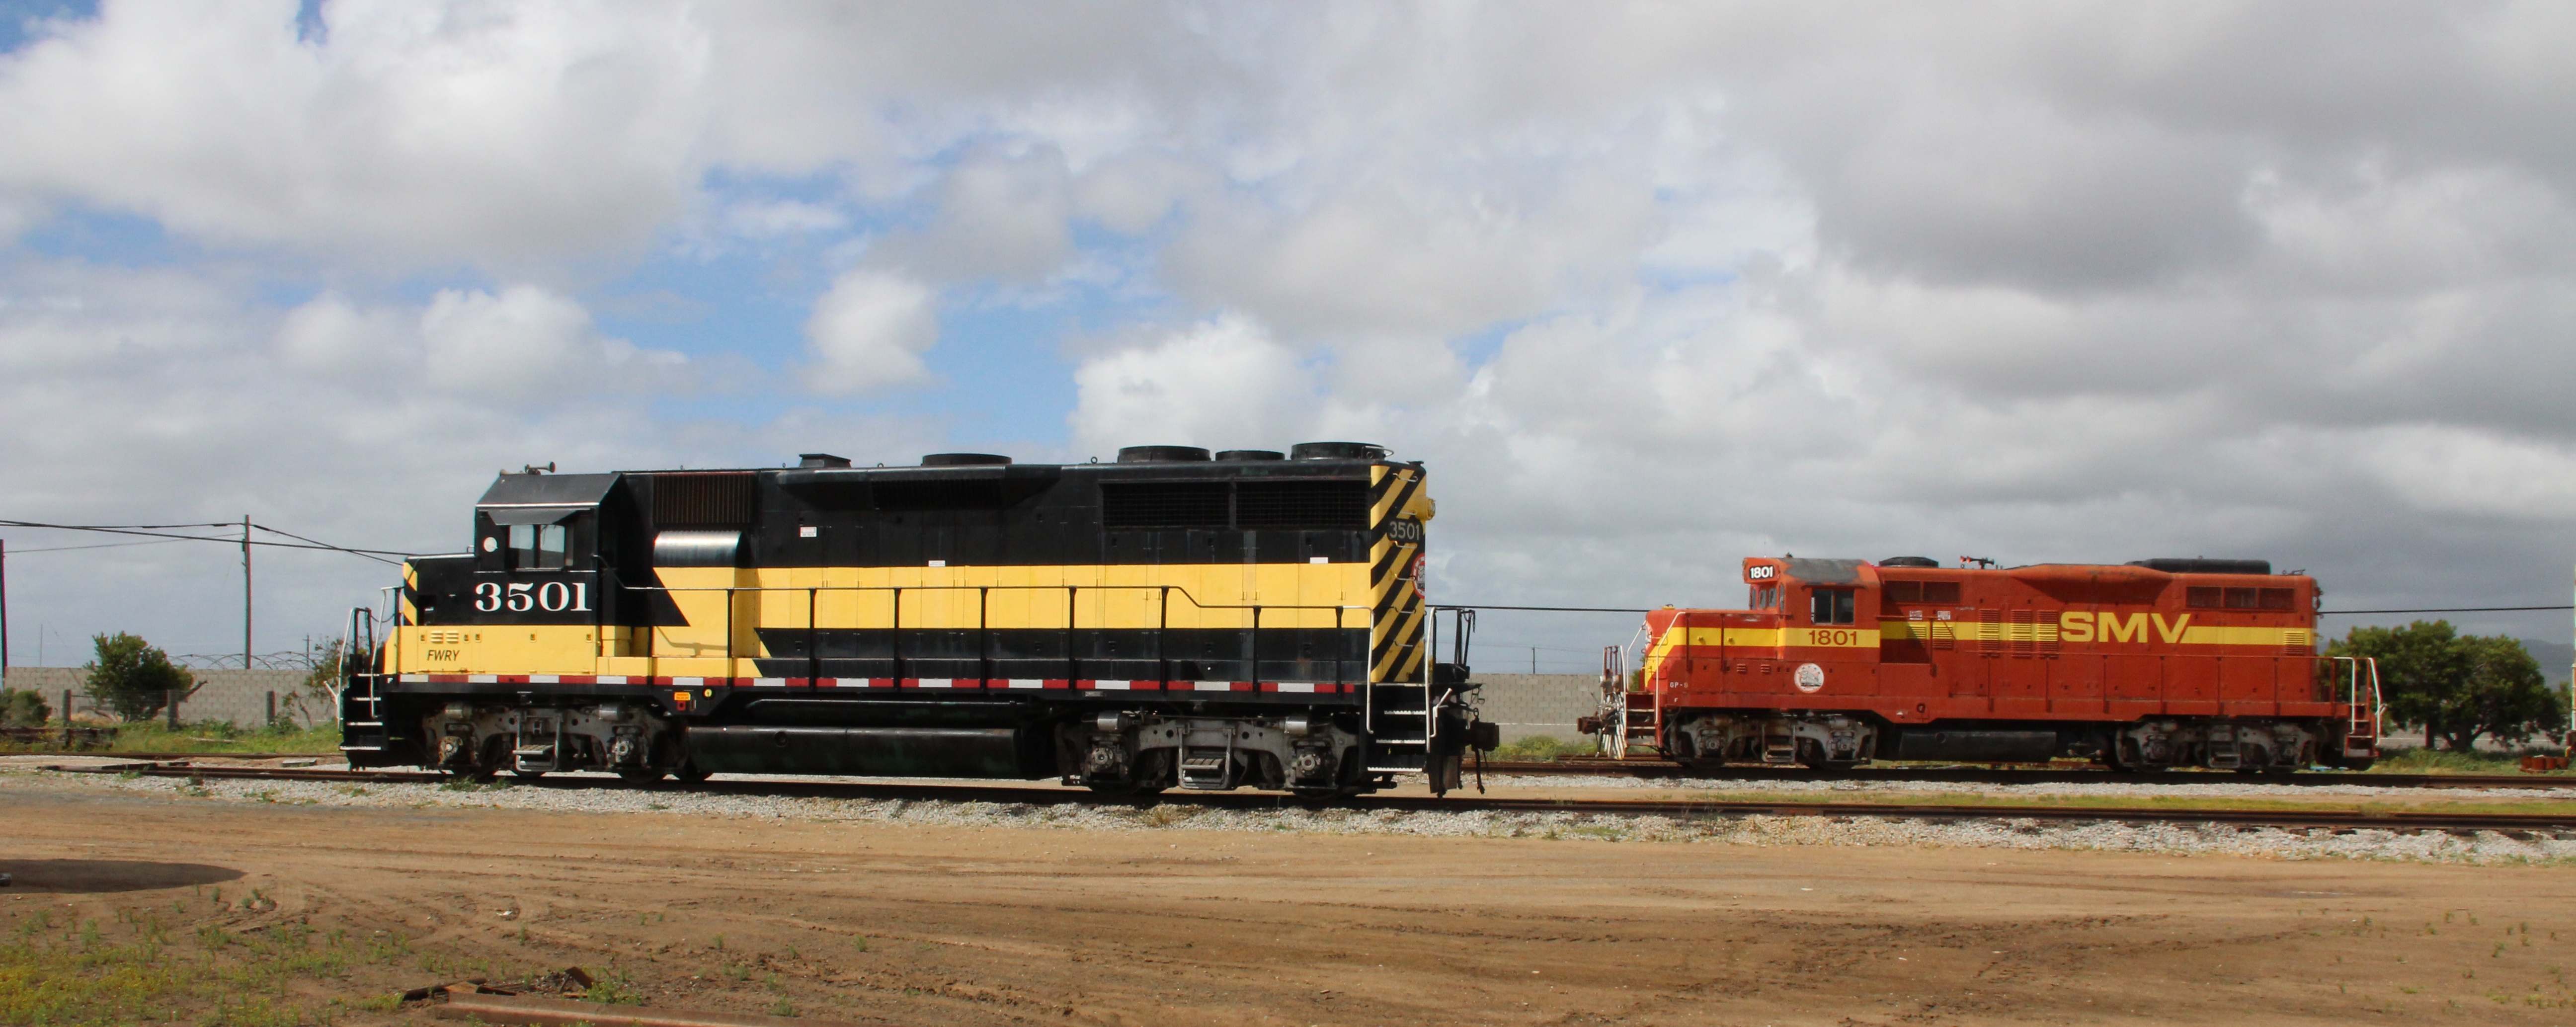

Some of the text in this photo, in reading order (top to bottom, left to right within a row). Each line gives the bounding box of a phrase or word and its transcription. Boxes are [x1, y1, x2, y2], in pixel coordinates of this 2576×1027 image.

[1389, 521, 1420, 541] 3501
[1750, 566, 1773, 579] 1801
[475, 582, 592, 612] 3501
[2061, 611, 2191, 643] SMV
[1809, 630, 1857, 646] 1801
[427, 649, 460, 661] FWRY
